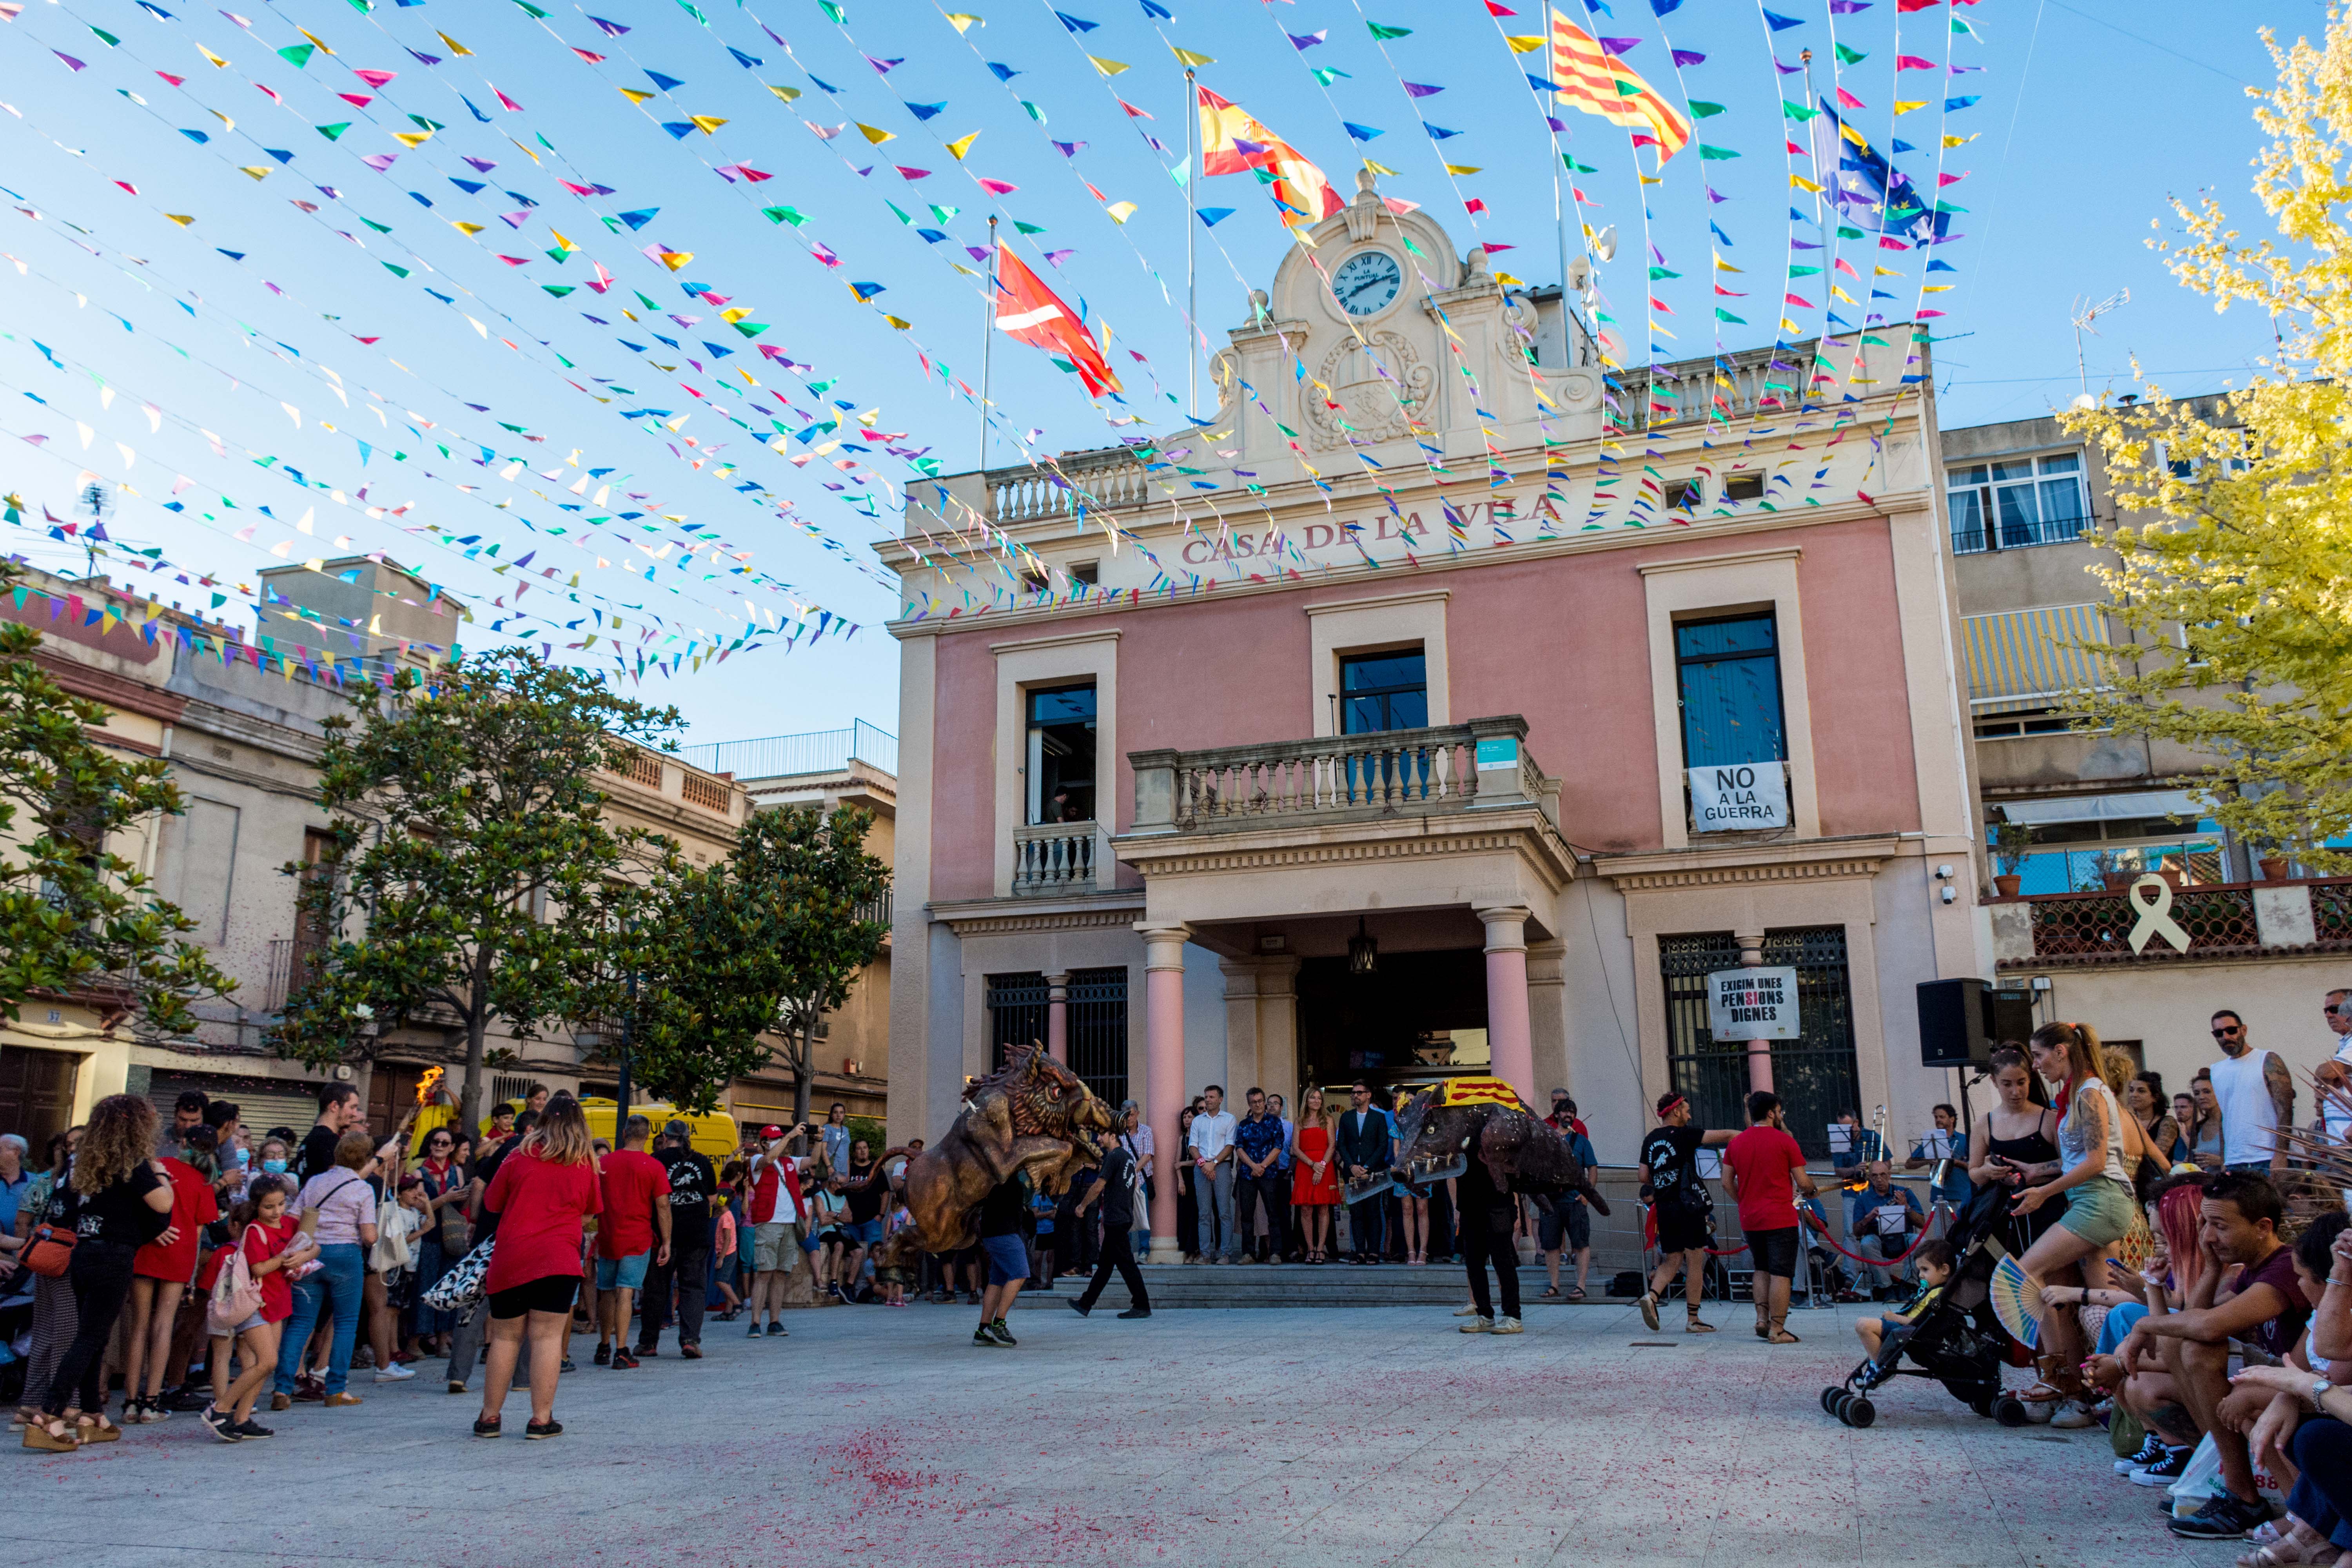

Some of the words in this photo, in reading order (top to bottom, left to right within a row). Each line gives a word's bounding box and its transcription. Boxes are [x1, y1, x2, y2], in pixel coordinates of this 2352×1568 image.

[1347, 262, 1357, 272] XI
[1361, 256, 1371, 266] XII
[1386, 265, 1396, 273] II
[1354, 273, 1379, 281] PUNTUAL
[1334, 287, 1344, 295] IX
[1348, 305, 1358, 314] VII
[1182, 531, 1285, 564] CASA
[1303, 516, 1359, 550] DE
[1375, 512, 1430, 541] LA
[1455, 494, 1560, 528] VILA
[1717, 767, 1755, 791] NO
[1720, 793, 1730, 805] A
[1736, 791, 1756, 804] LA
[1705, 805, 1774, 820] GUERRA
[1721, 978, 1754, 992] EXIGIM
[1758, 978, 1782, 989] UNES
[1721, 991, 1784, 1007] PENSIONS
[1731, 1006, 1777, 1023] DIGNES
